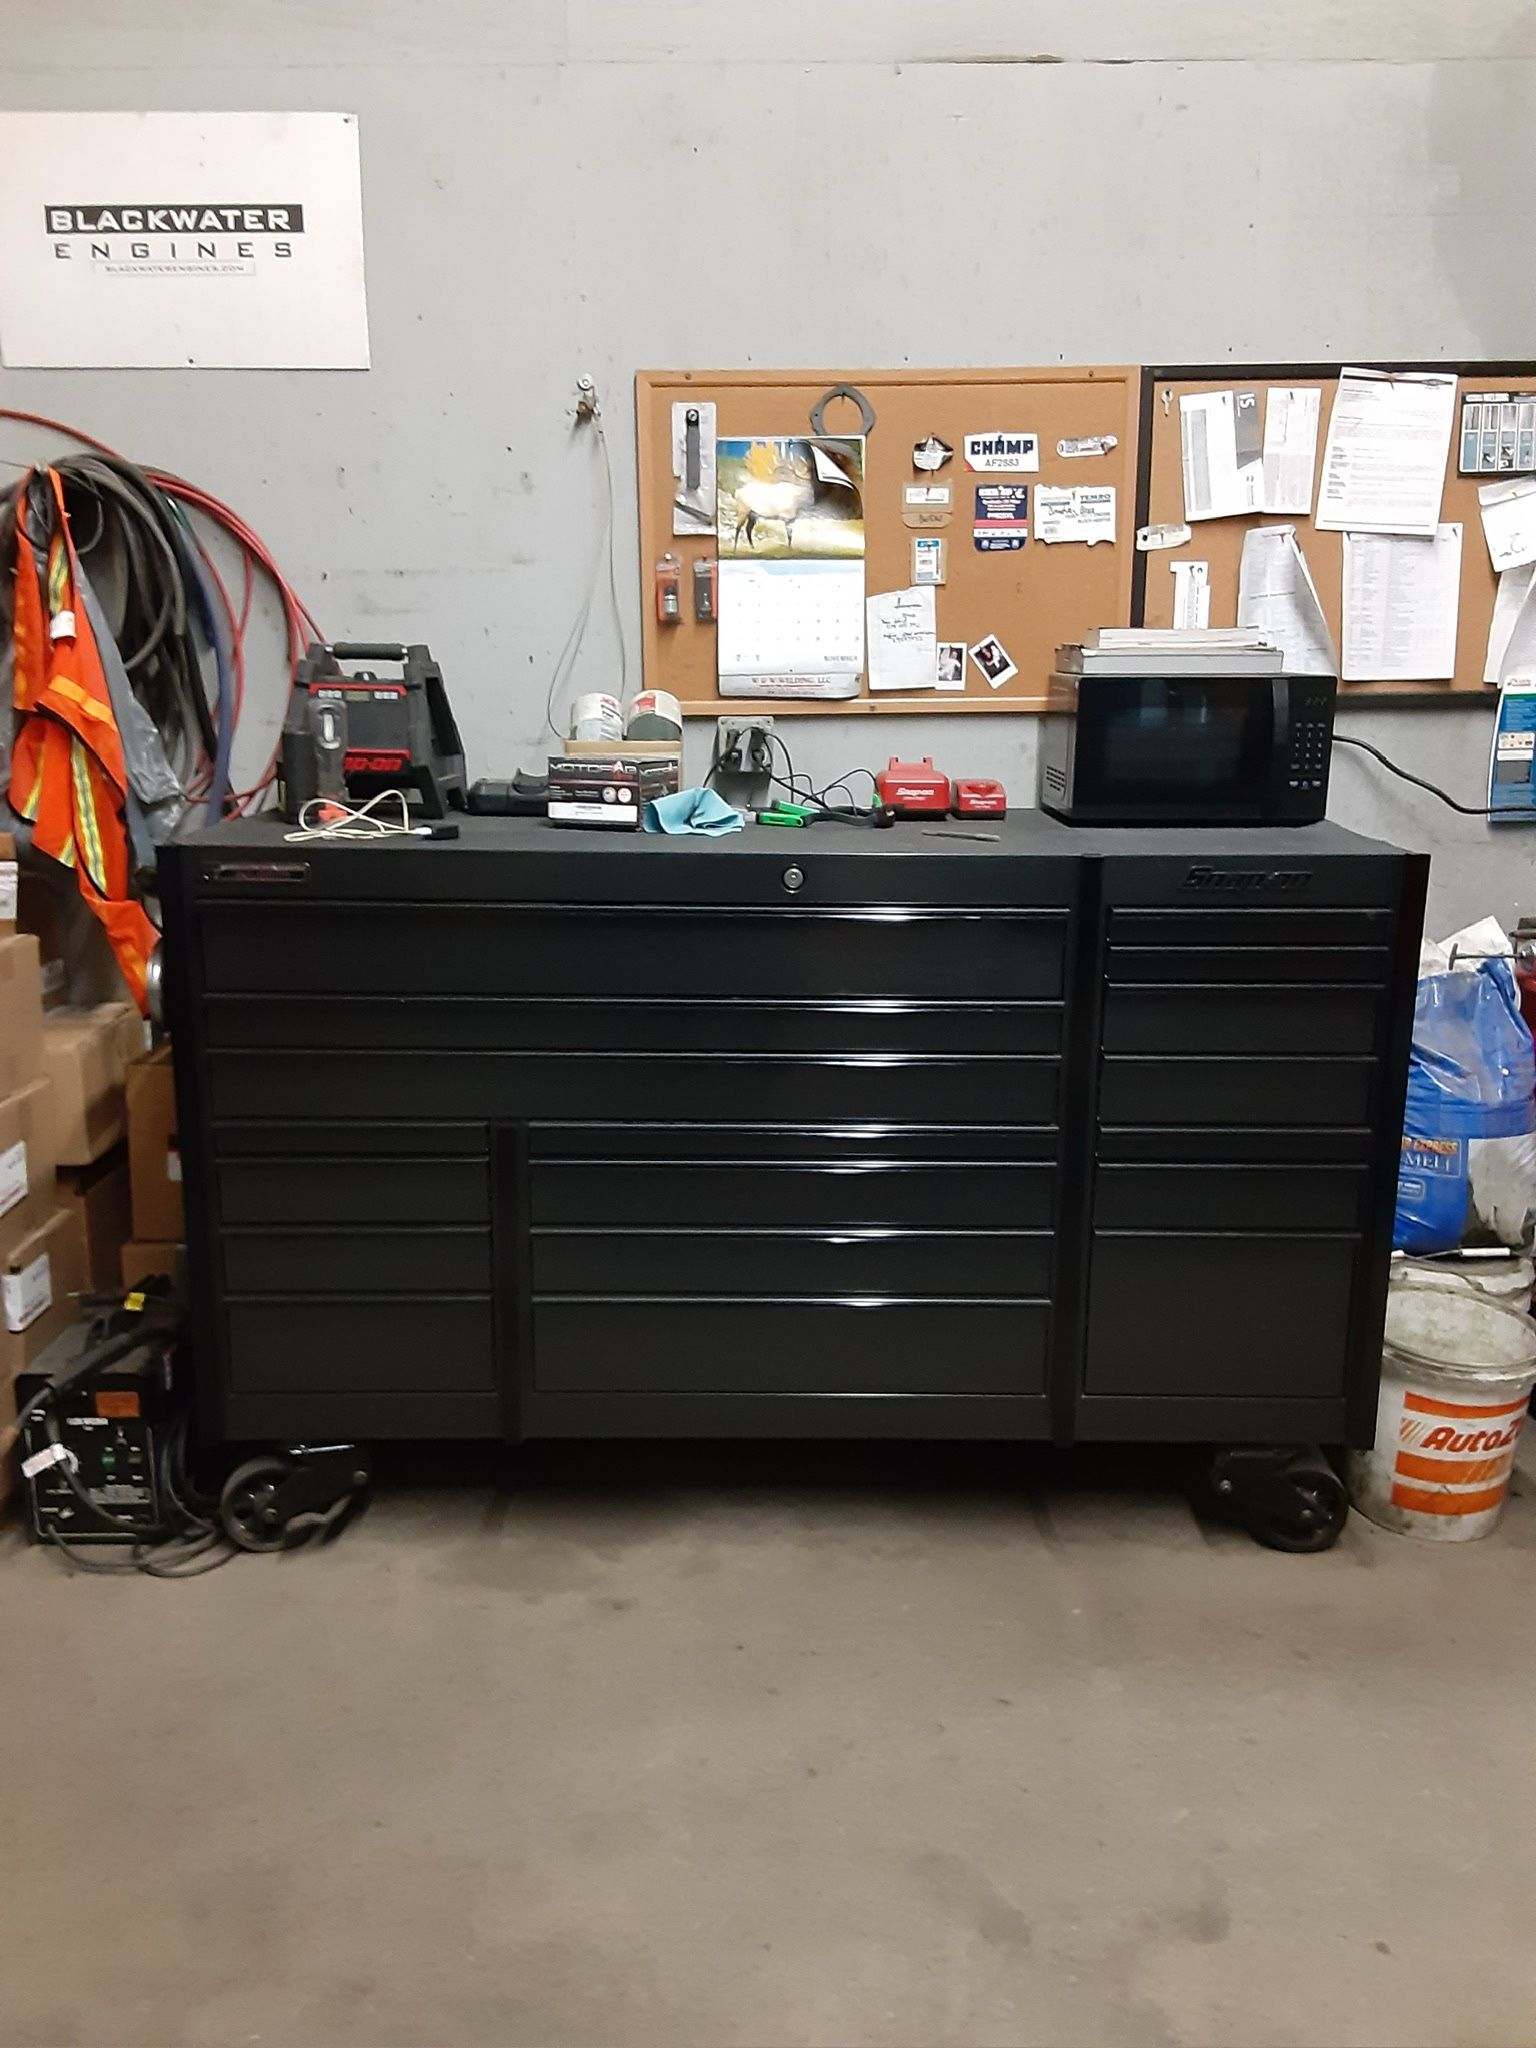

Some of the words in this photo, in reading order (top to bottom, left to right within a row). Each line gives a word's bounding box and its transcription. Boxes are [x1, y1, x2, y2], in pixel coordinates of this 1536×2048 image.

[50, 209, 291, 231] BLACKWATER
[54, 242, 292, 259] ENGINES
[971, 440, 1034, 455] CHAMP
[1183, 865, 1313, 889] Snap-on
